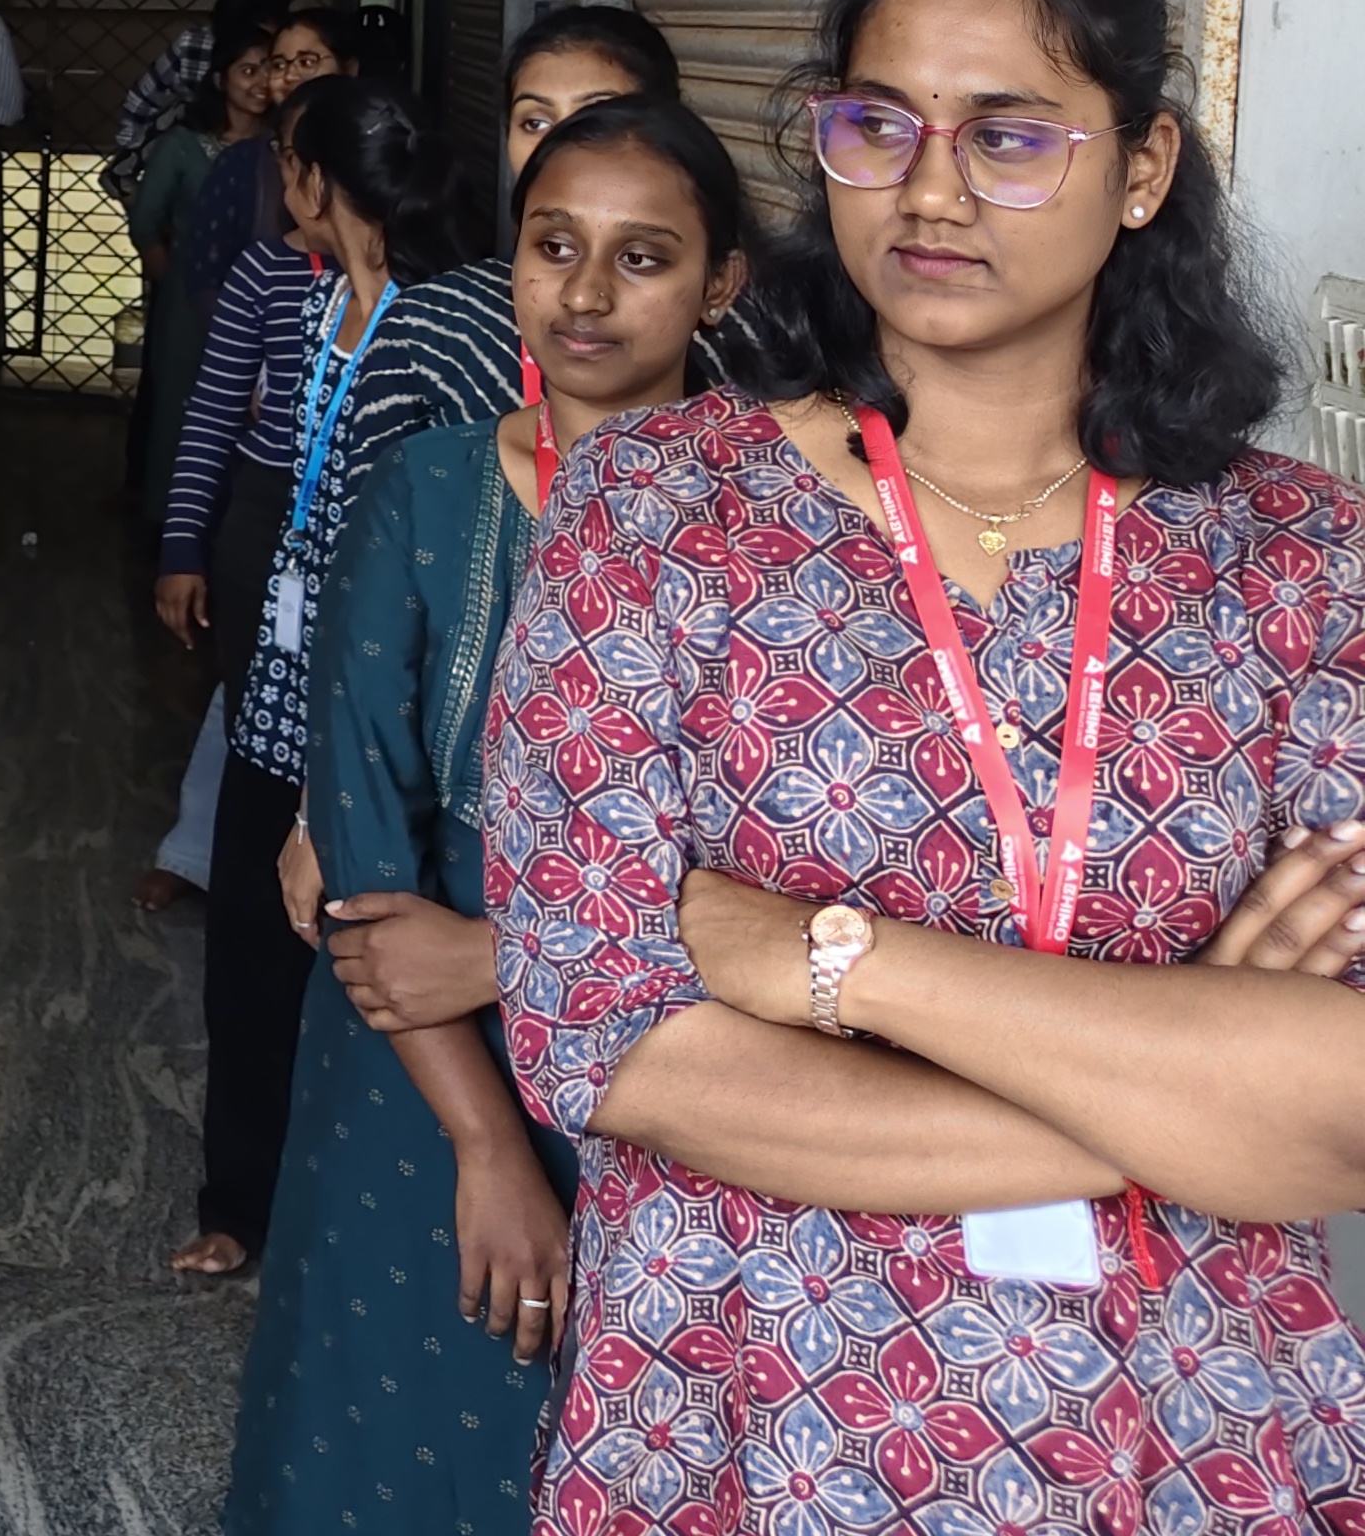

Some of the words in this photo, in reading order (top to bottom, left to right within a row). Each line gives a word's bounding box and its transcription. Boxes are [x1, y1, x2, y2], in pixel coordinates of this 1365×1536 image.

[876, 478, 908, 544] ABHIMO
[1098, 510, 1116, 577] ABHIMO
[1083, 677, 1103, 749] ABHIMO
[1053, 866, 1079, 942] ABHIMO
